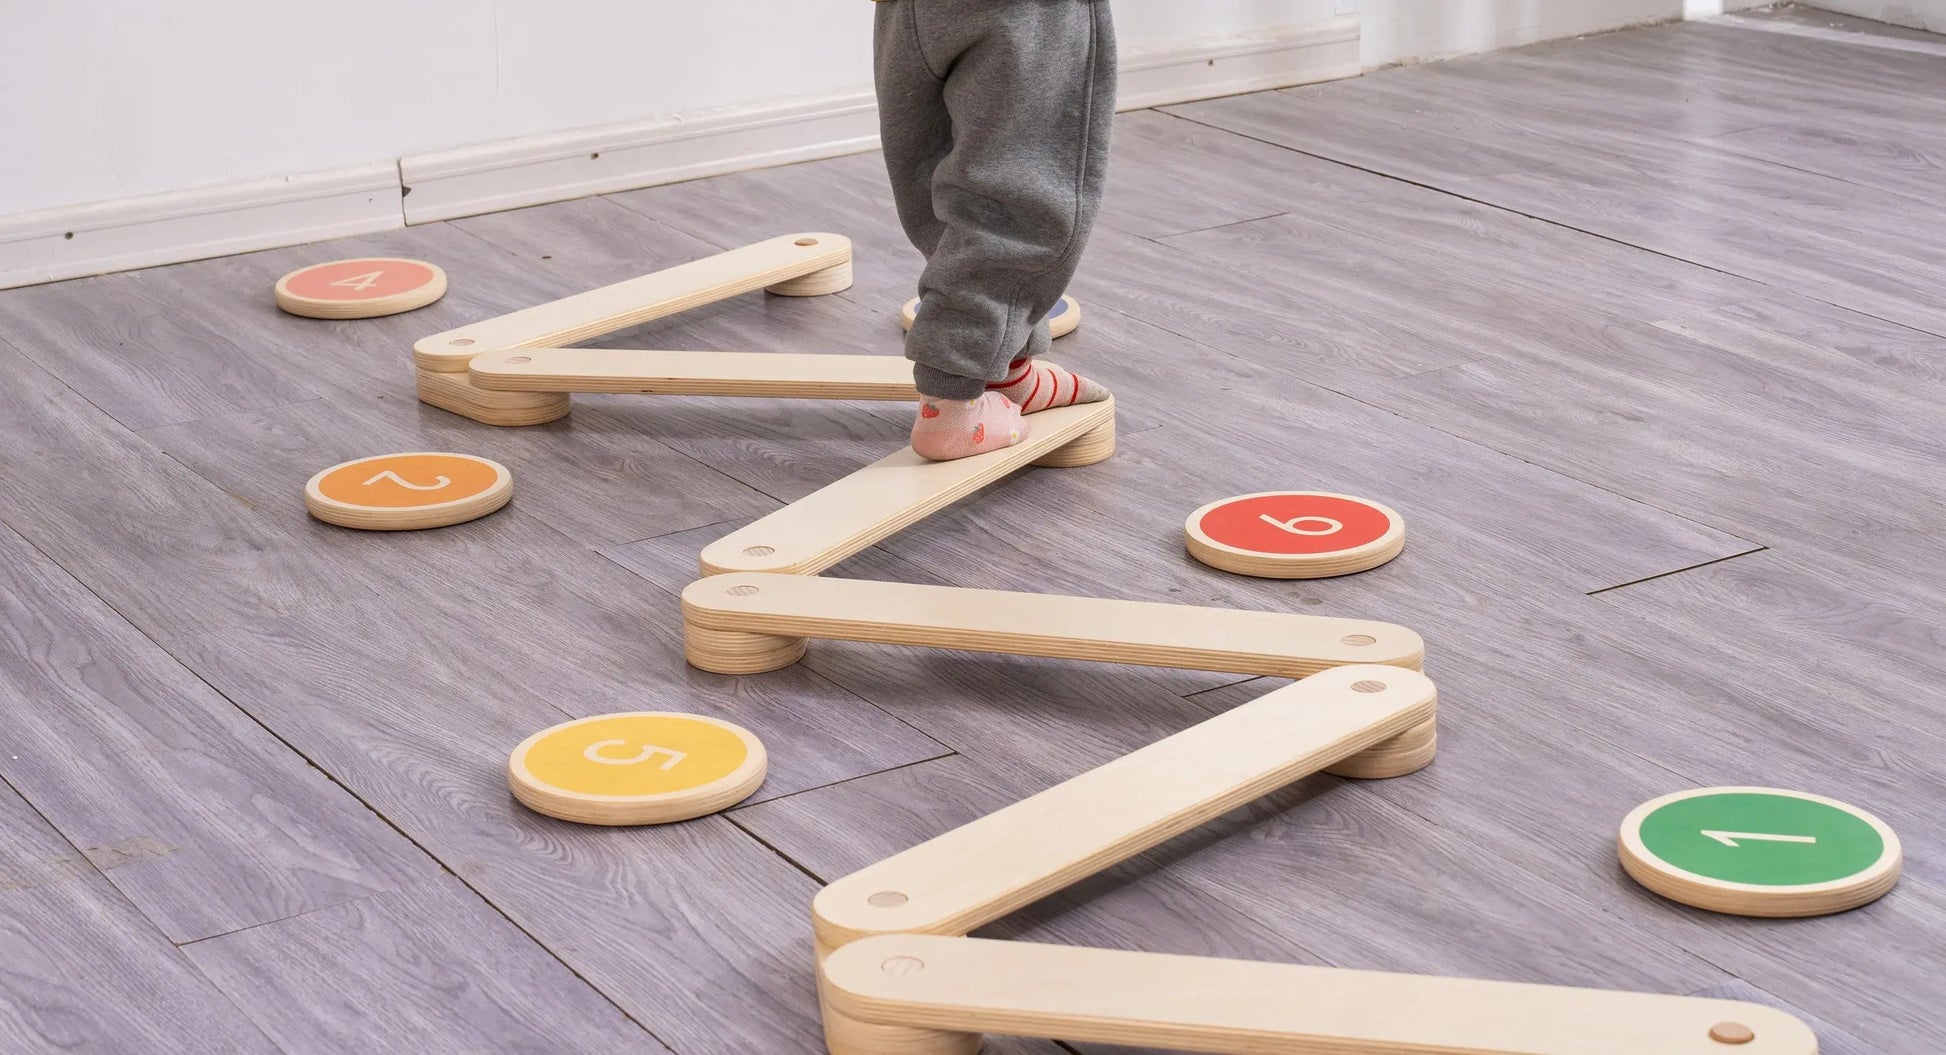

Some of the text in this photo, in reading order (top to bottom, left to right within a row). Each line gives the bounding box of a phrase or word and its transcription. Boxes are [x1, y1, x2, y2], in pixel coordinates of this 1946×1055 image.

[330, 270, 383, 290] 4
[361, 470, 451, 491] 2
[583, 739, 687, 770] 5
[1700, 829, 1817, 848] 1
